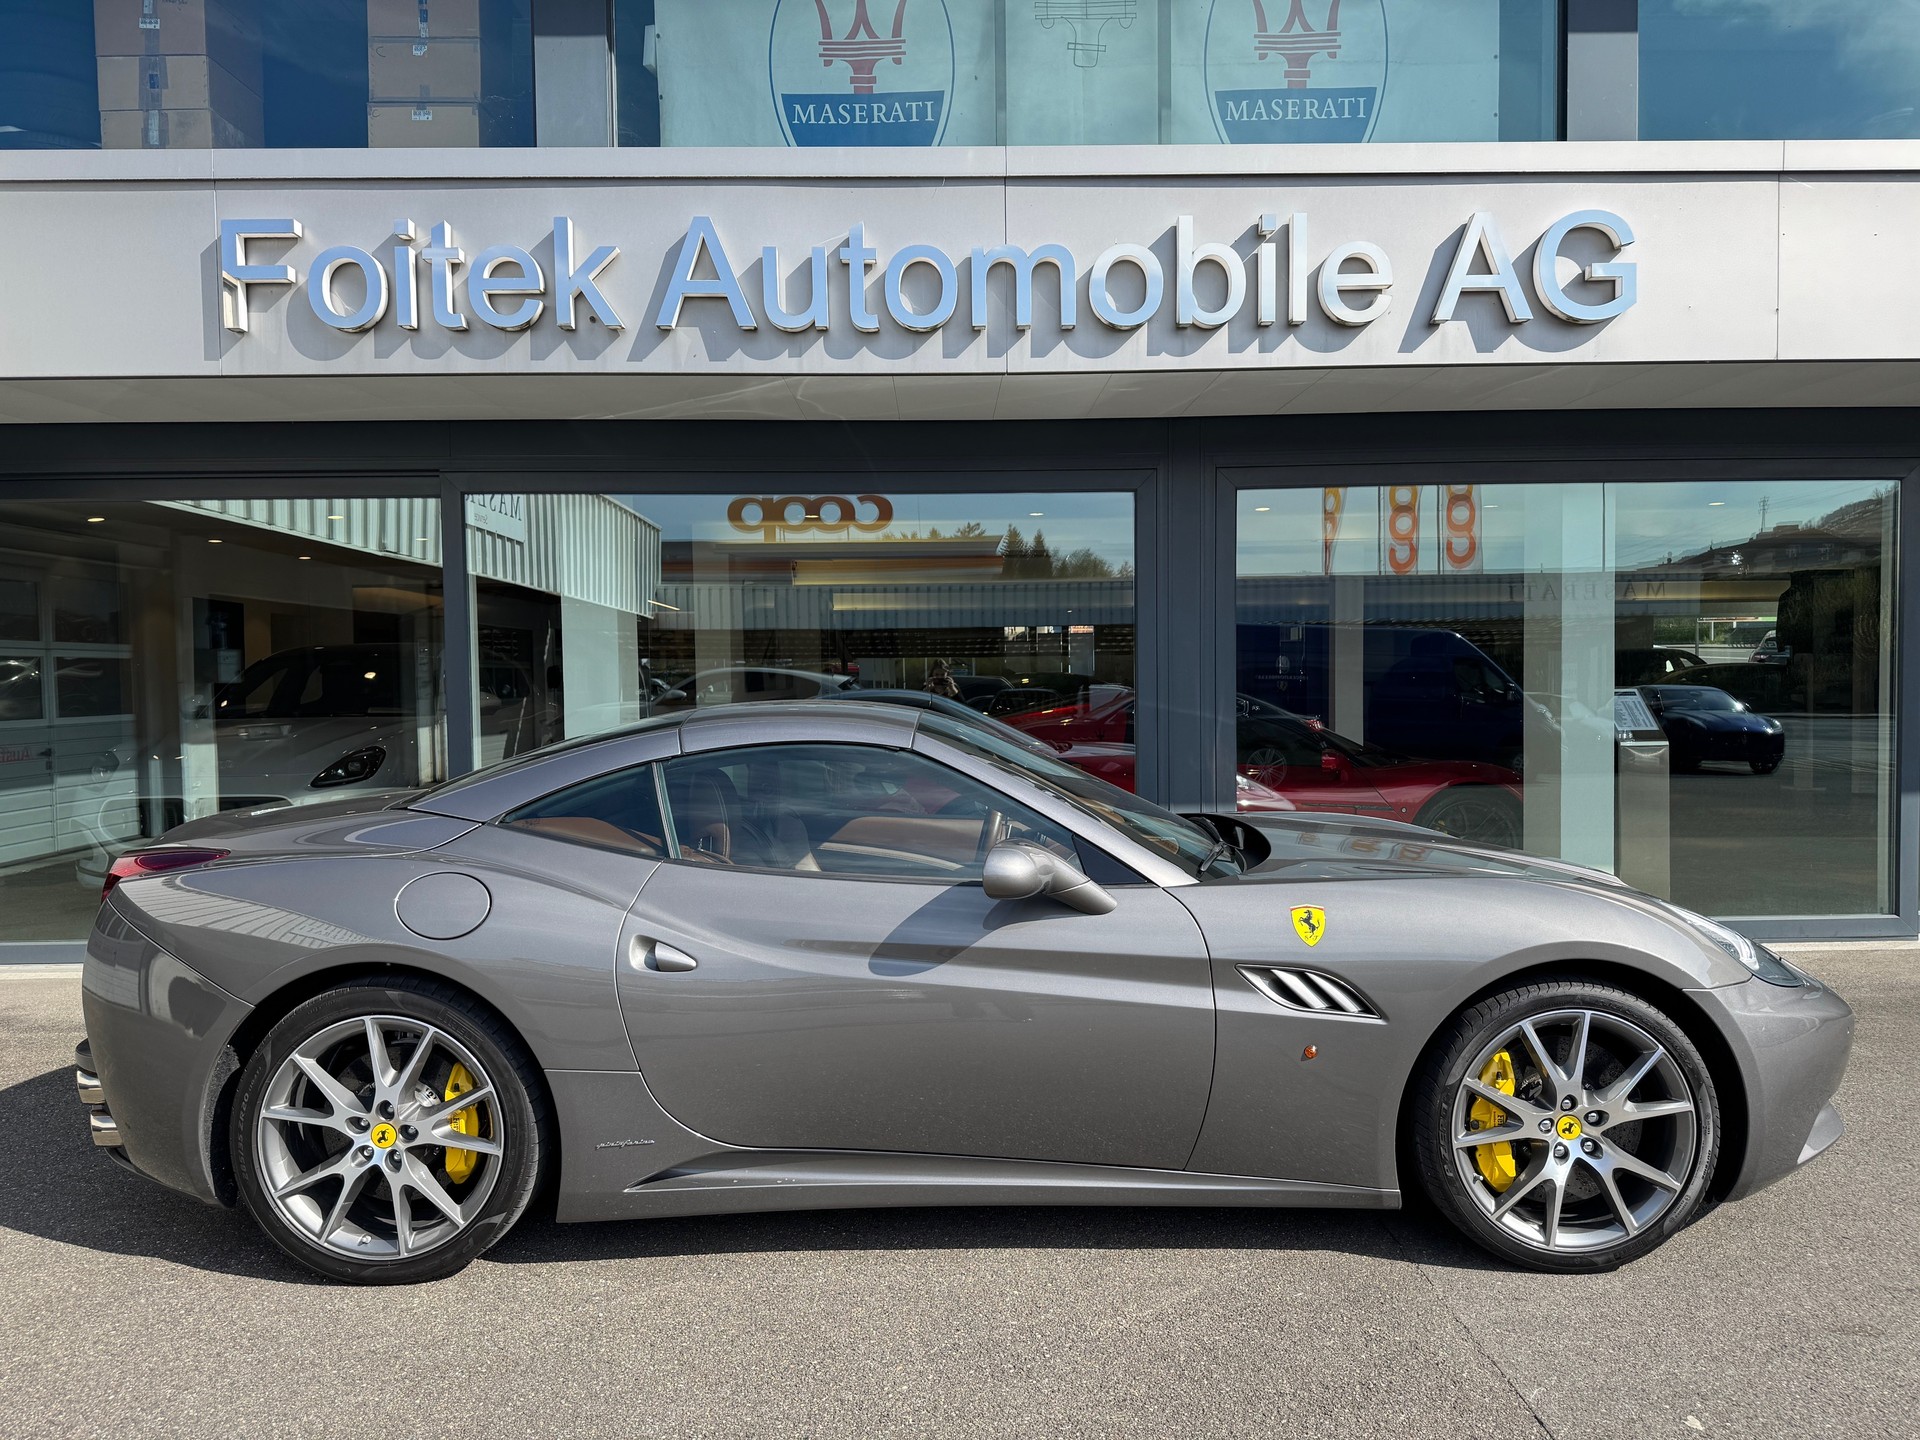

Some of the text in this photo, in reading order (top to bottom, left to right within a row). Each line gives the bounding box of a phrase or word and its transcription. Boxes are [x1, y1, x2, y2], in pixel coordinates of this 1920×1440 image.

[792, 101, 936, 124] MASERATI
[1225, 97, 1367, 121] MASERATI
[221, 209, 1637, 332] Foitek Automobile AG
